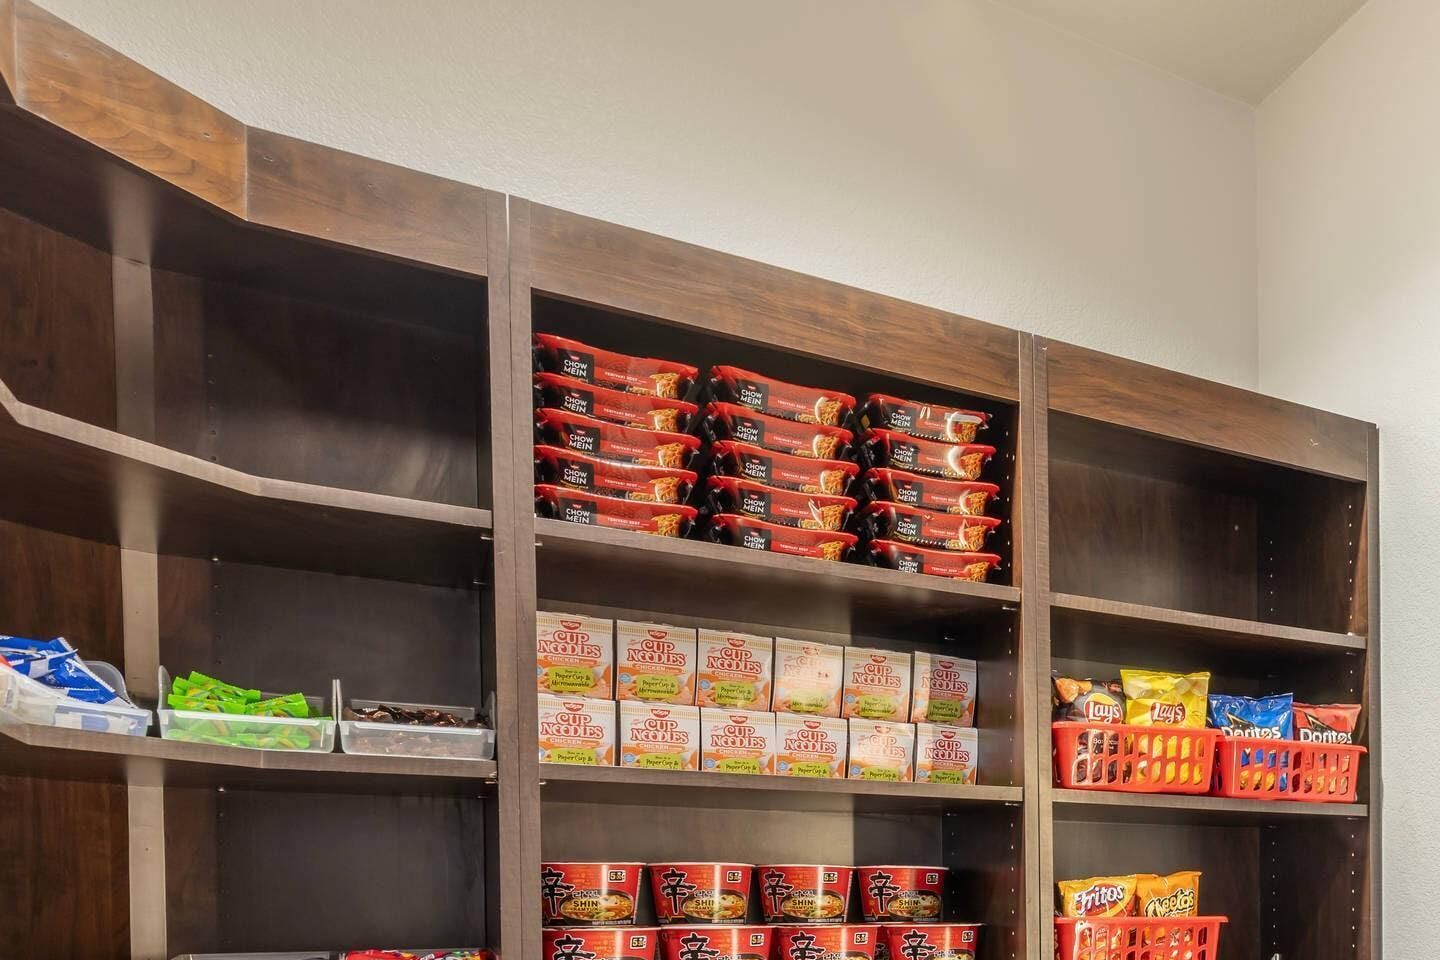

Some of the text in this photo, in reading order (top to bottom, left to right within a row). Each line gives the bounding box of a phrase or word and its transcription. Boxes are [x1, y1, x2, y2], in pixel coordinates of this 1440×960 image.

[564, 360, 587, 369] CHOW
[564, 366, 586, 377] MEIN
[565, 396, 587, 406] CHOW
[564, 402, 586, 413] MEIN
[737, 432, 757, 441] MEIN
[738, 426, 758, 435] CHOW
[570, 434, 593, 443] CHOW
[569, 440, 592, 450] MEIN
[745, 468, 765, 477] MEIN
[746, 463, 766, 471] CHOW
[564, 469, 587, 478] CHOW
[564, 475, 586, 485] MEIN
[744, 499, 765, 507] CHOW
[744, 504, 764, 513] MEIN
[566, 508, 590, 517] CHOW
[566, 514, 589, 523] MEIN
[898, 527, 916, 535] MEIN
[554, 630, 589, 645] CUP
[538, 640, 601, 658] NOODLES
[641, 640, 675, 652] CUP
[627, 648, 687, 666] NOODLES
[720, 648, 752, 660] CUP
[707, 656, 761, 674] NOODLES
[864, 664, 892, 676] CUP
[853, 672, 901, 688] NOODLES
[933, 669, 959, 681] CUP
[922, 677, 968, 693] NOODLES
[1089, 700, 1121, 722] Lay's
[1153, 703, 1183, 722] Lay's
[556, 714, 592, 726] CUP
[644, 720, 677, 731] CUP
[541, 722, 604, 739] NOODLES
[631, 728, 689, 744] NOODLES
[724, 726, 755, 737] CUP
[797, 730, 827, 741] CUP
[1221, 726, 1281, 739] Doritos
[1300, 727, 1352, 743] Doritos
[711, 734, 766, 749] NOODLES
[785, 738, 837, 753] NOODLES
[936, 740, 961, 750] CUP
[925, 749, 969, 762] NOODLES
[1073, 884, 1125, 914] Fritos
[1145, 888, 1194, 916] Cheetos
